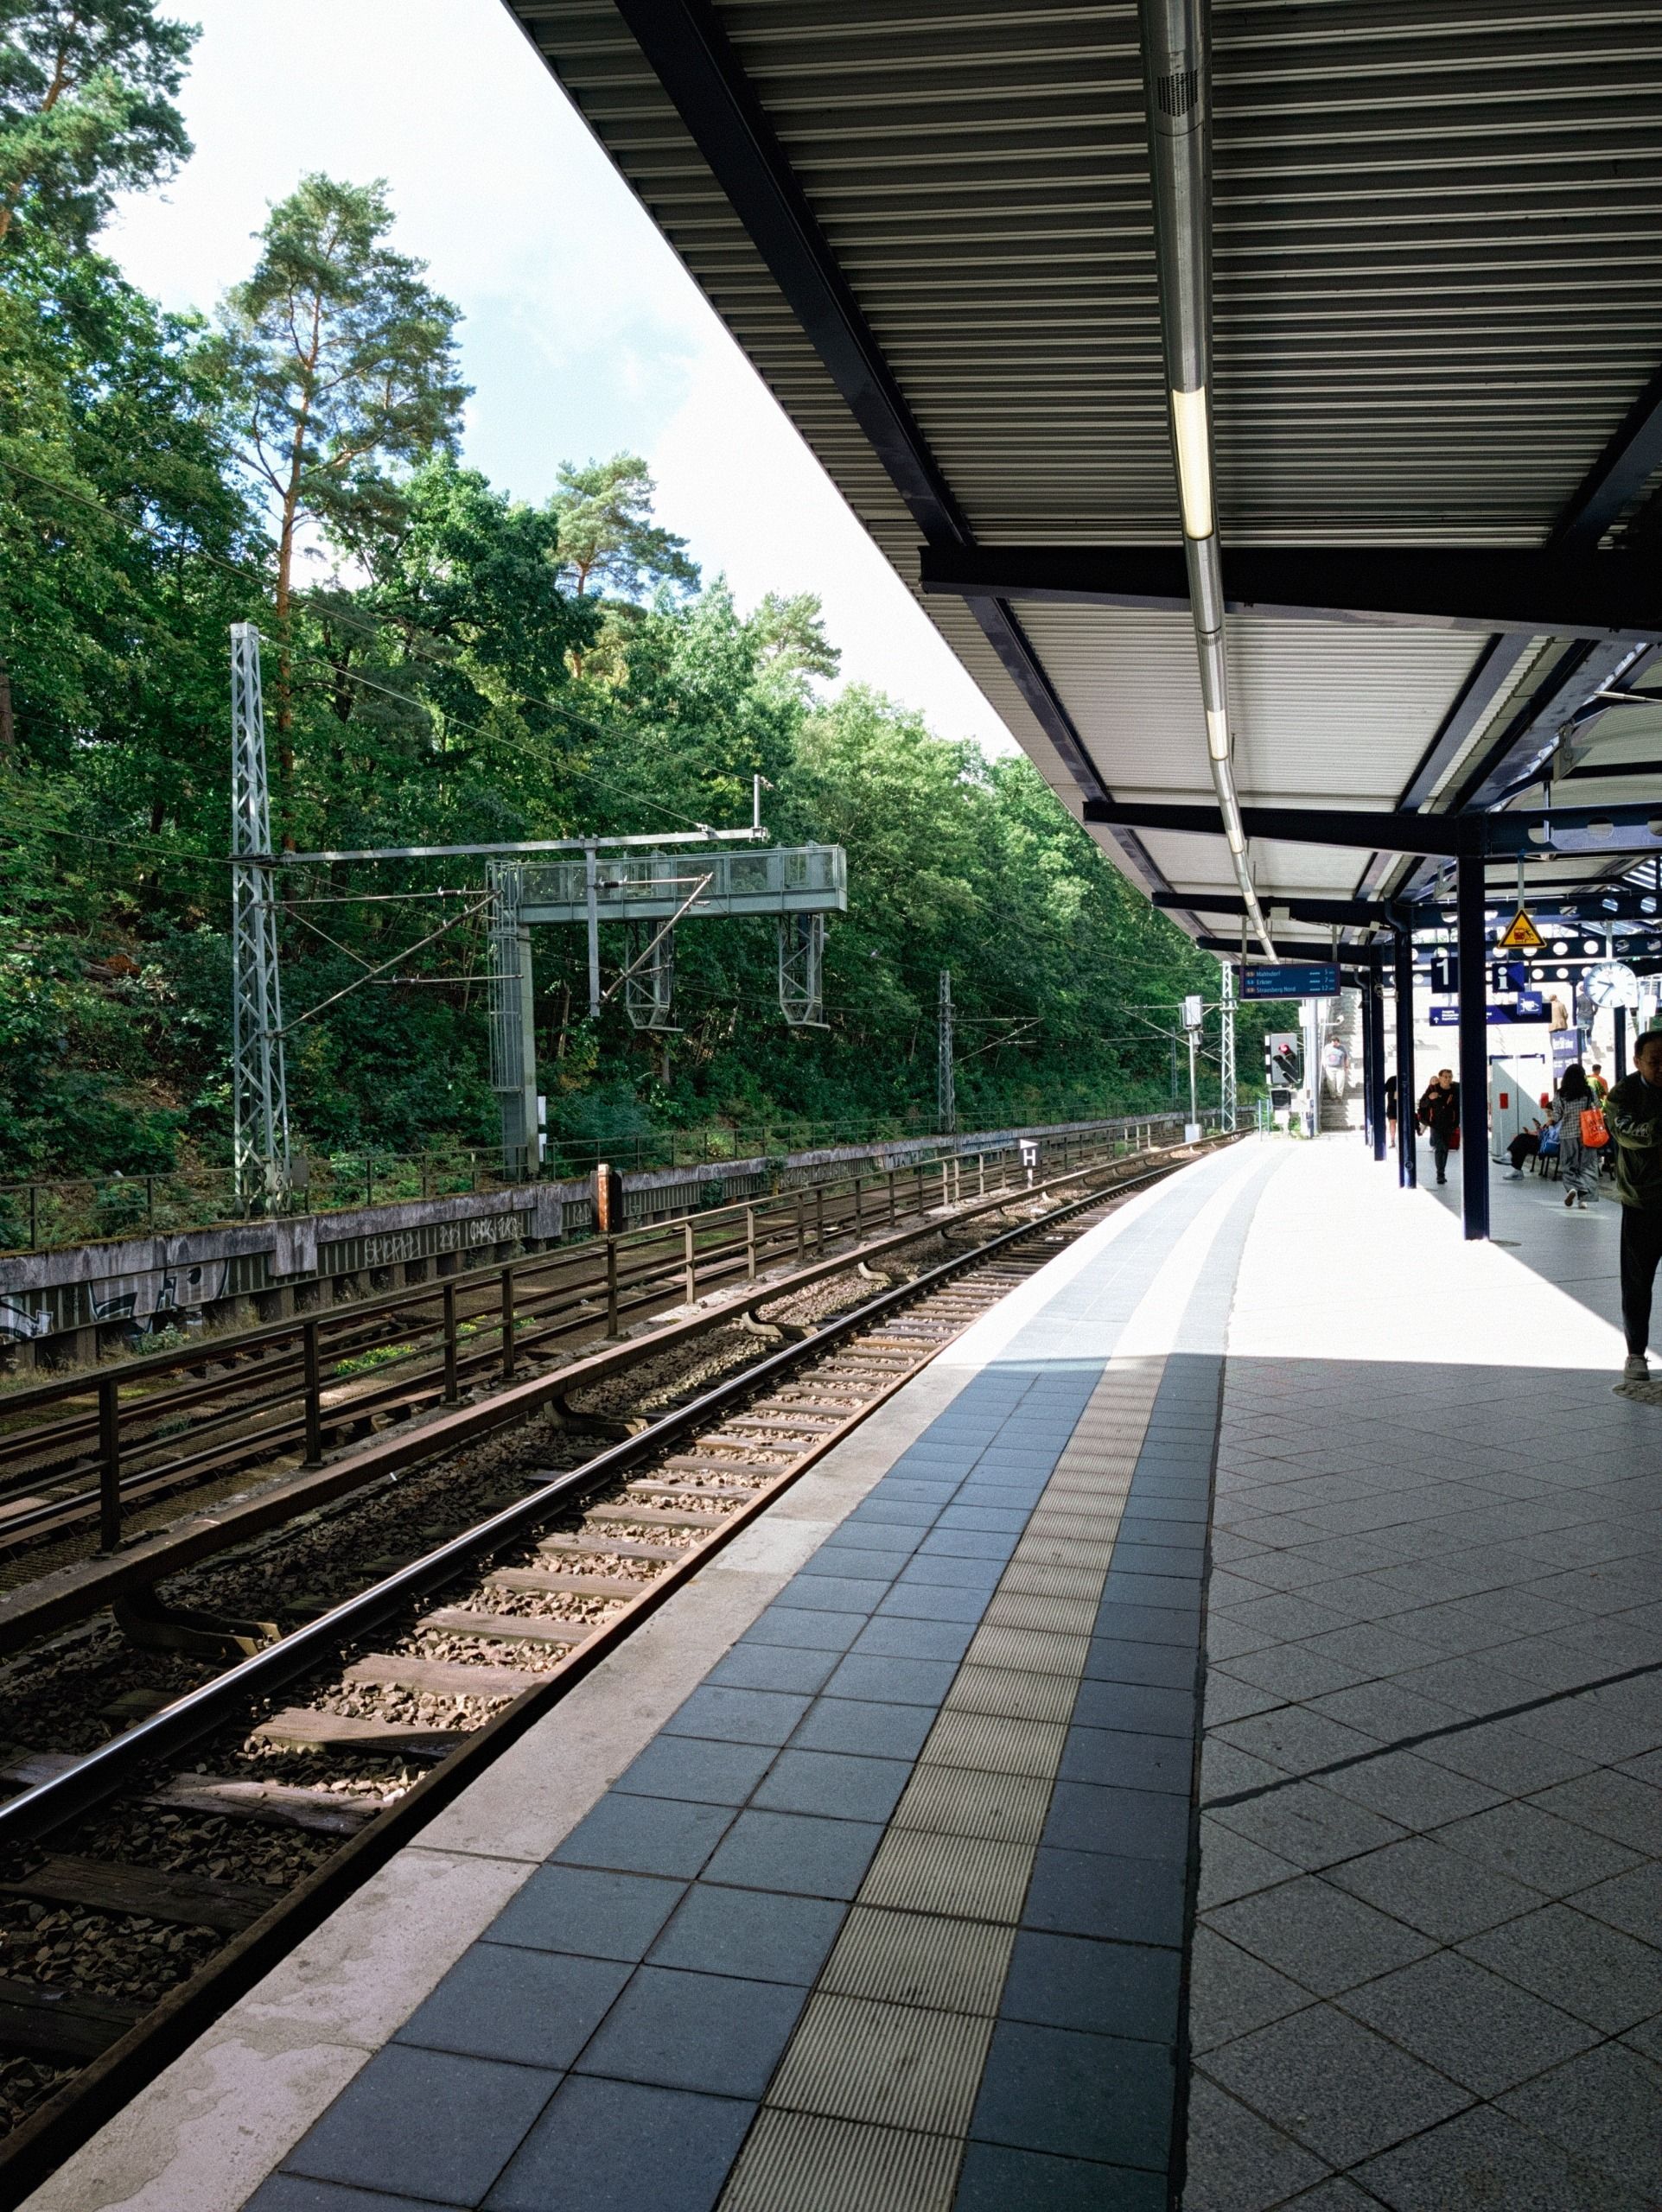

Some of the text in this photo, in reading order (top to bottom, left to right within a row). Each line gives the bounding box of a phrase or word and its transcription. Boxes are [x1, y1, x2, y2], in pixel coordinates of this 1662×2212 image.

[1436, 958, 1449, 985] 1
[1023, 1149, 1035, 1166] H
[274, 1160, 283, 1173] 13
[276, 1174, 283, 1186] 6
